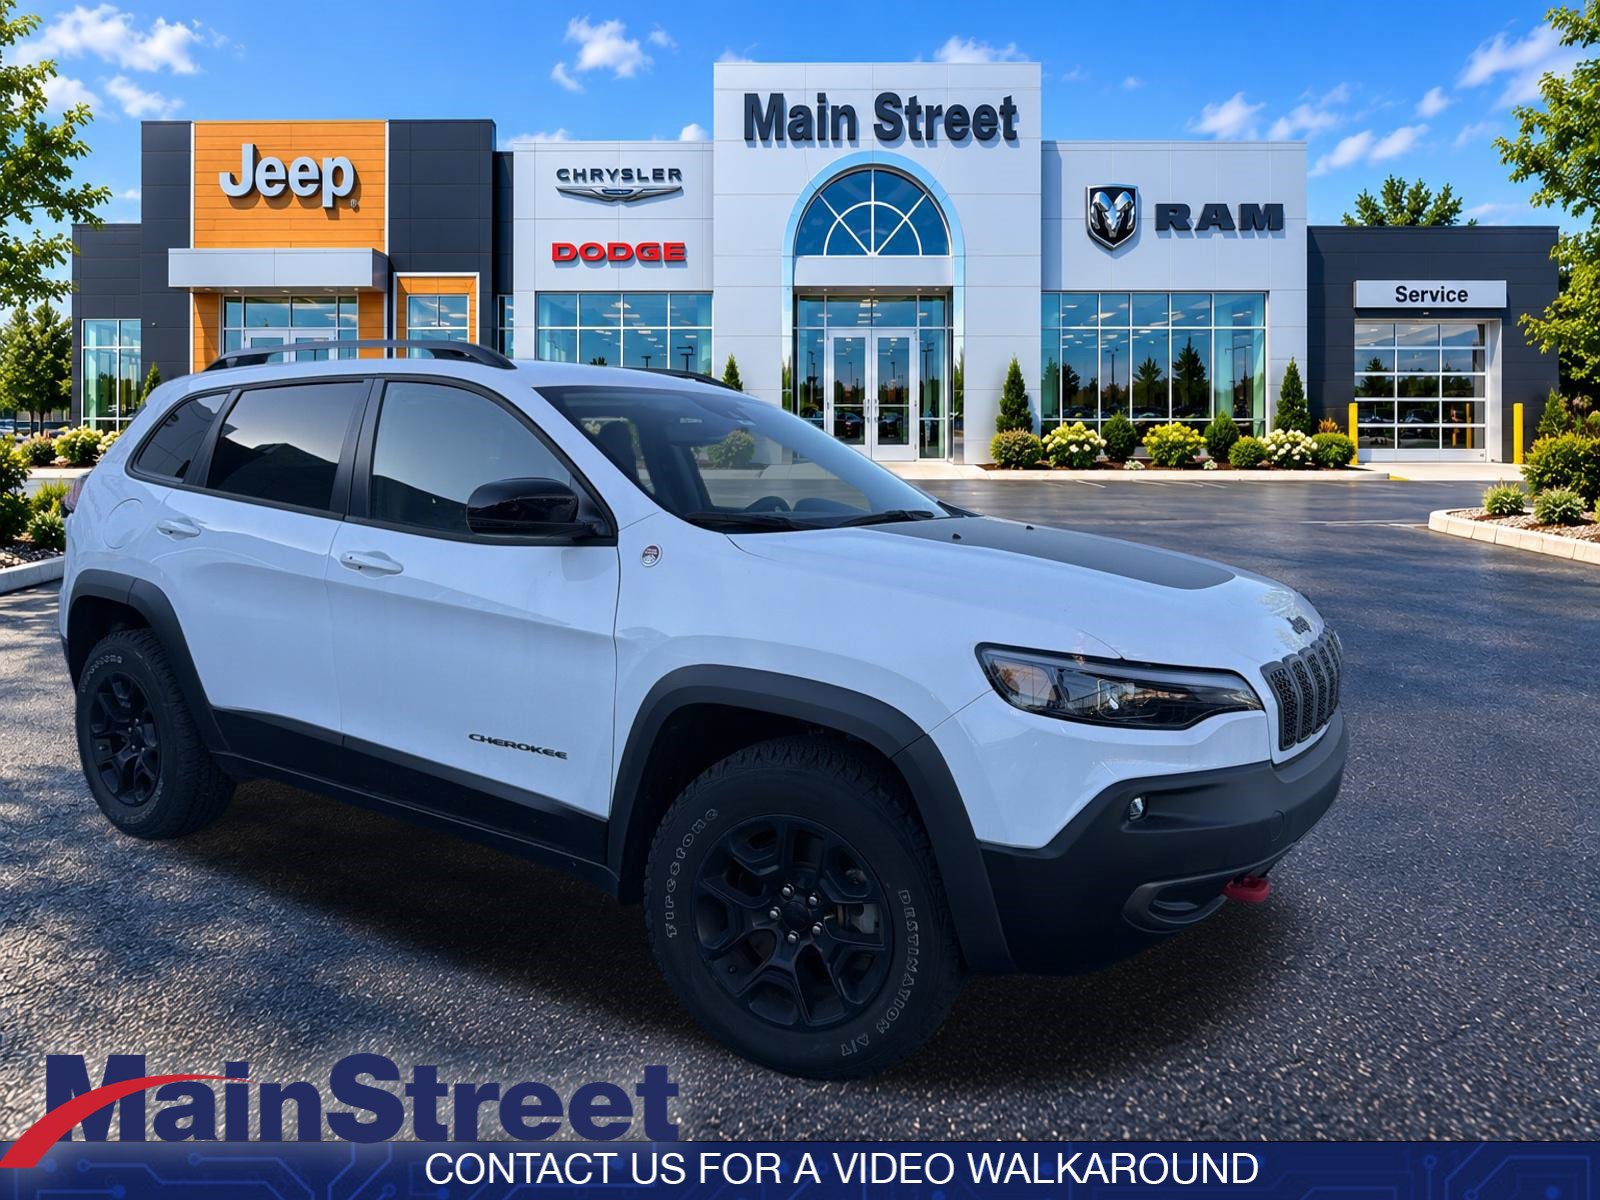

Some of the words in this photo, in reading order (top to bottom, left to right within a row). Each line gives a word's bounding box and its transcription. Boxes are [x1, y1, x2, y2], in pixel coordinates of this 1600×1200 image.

[743, 92, 857, 142] Main
[873, 91, 1018, 142] Street
[219, 143, 355, 208] Jeep
[556, 168, 683, 182] CHRYSLER
[1155, 203, 1284, 231] RAM
[551, 242, 687, 262] DODGE
[1395, 285, 1469, 303] Service
[468, 733, 568, 760] CHEROKEE
[875, 888, 921, 1034] DESTINATION
